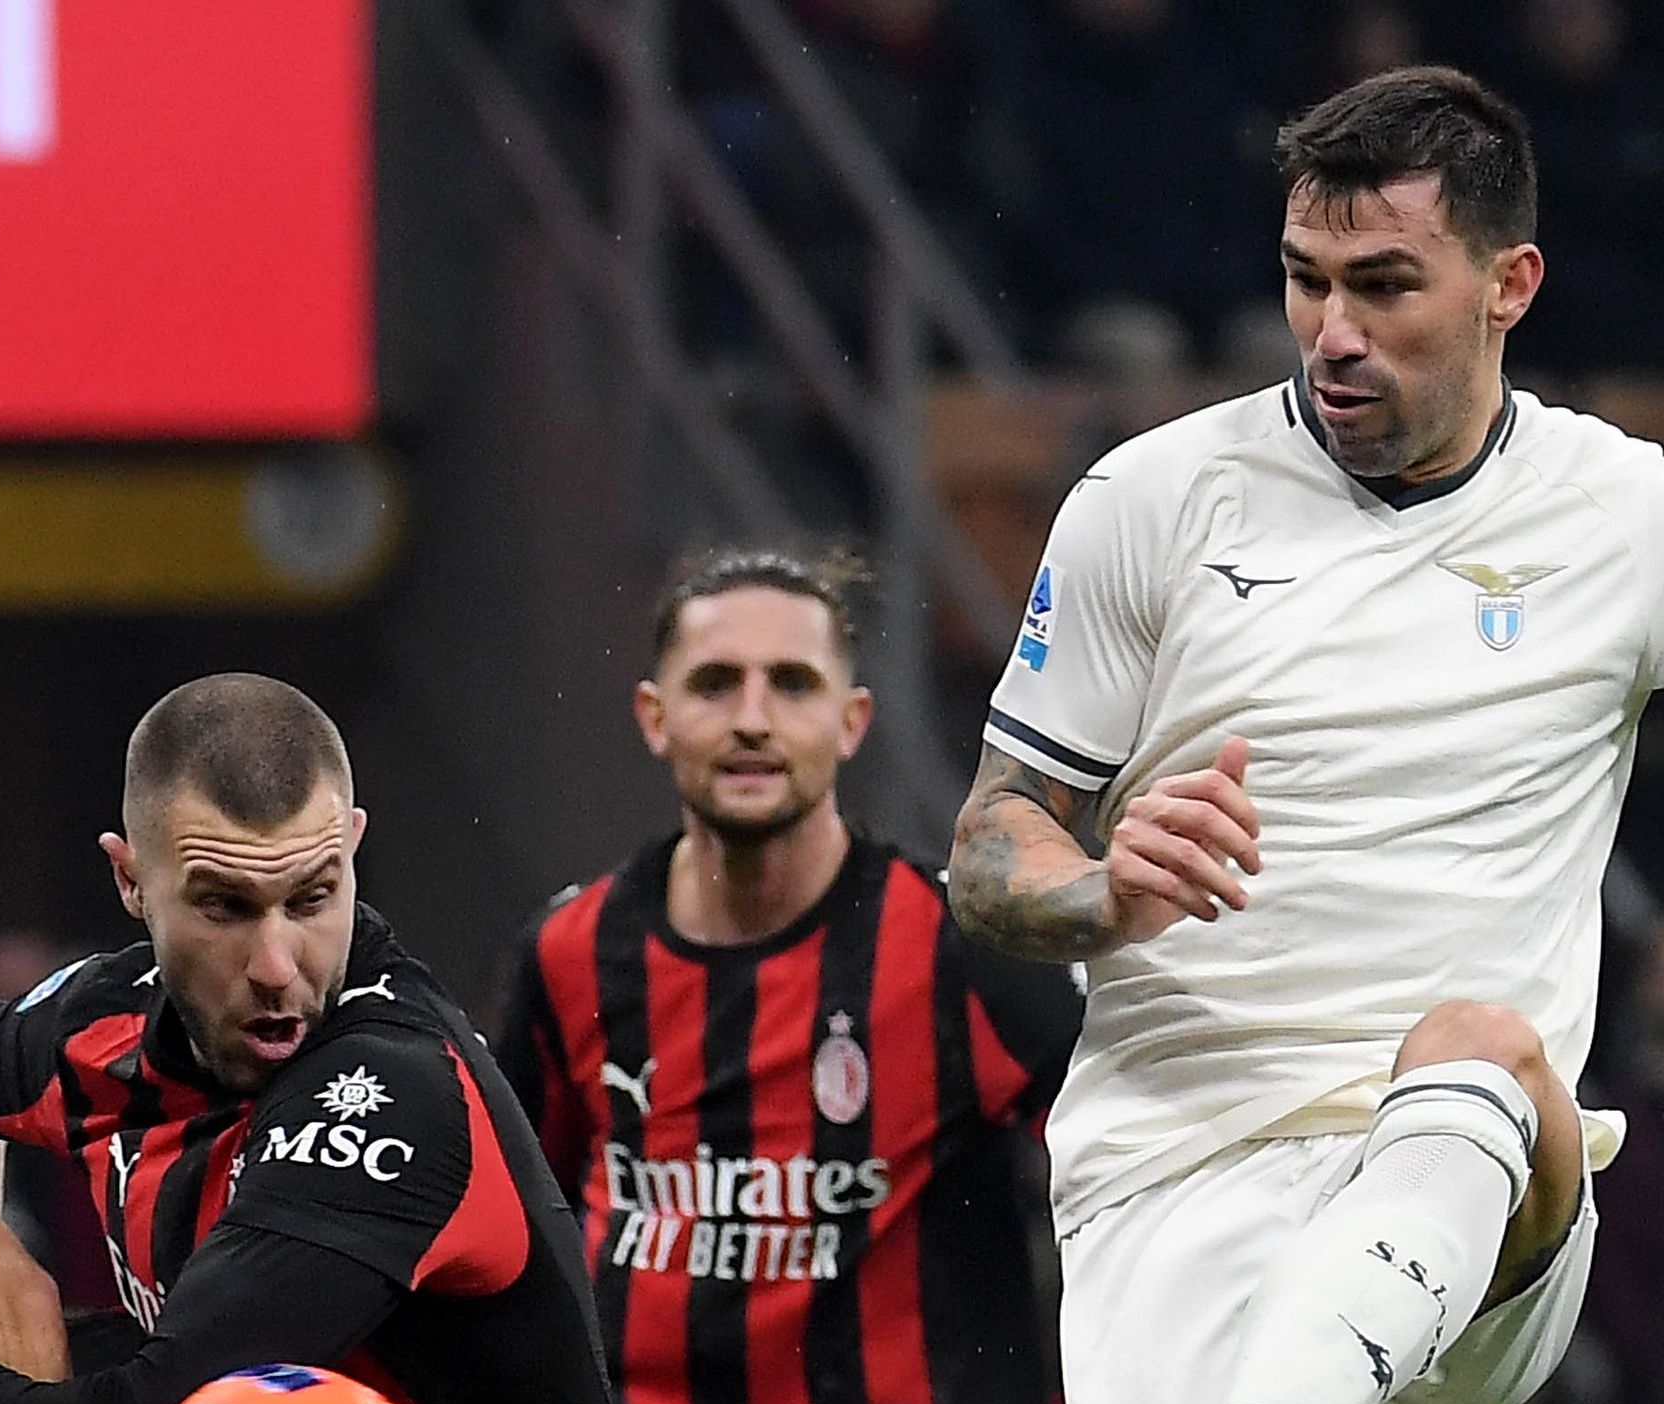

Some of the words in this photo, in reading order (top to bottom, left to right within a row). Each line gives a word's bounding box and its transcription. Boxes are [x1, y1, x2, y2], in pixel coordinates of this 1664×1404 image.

[258, 1121, 415, 1182] MSC
[602, 1142, 894, 1218] Emirates
[686, 1220, 842, 1282] BETTER
